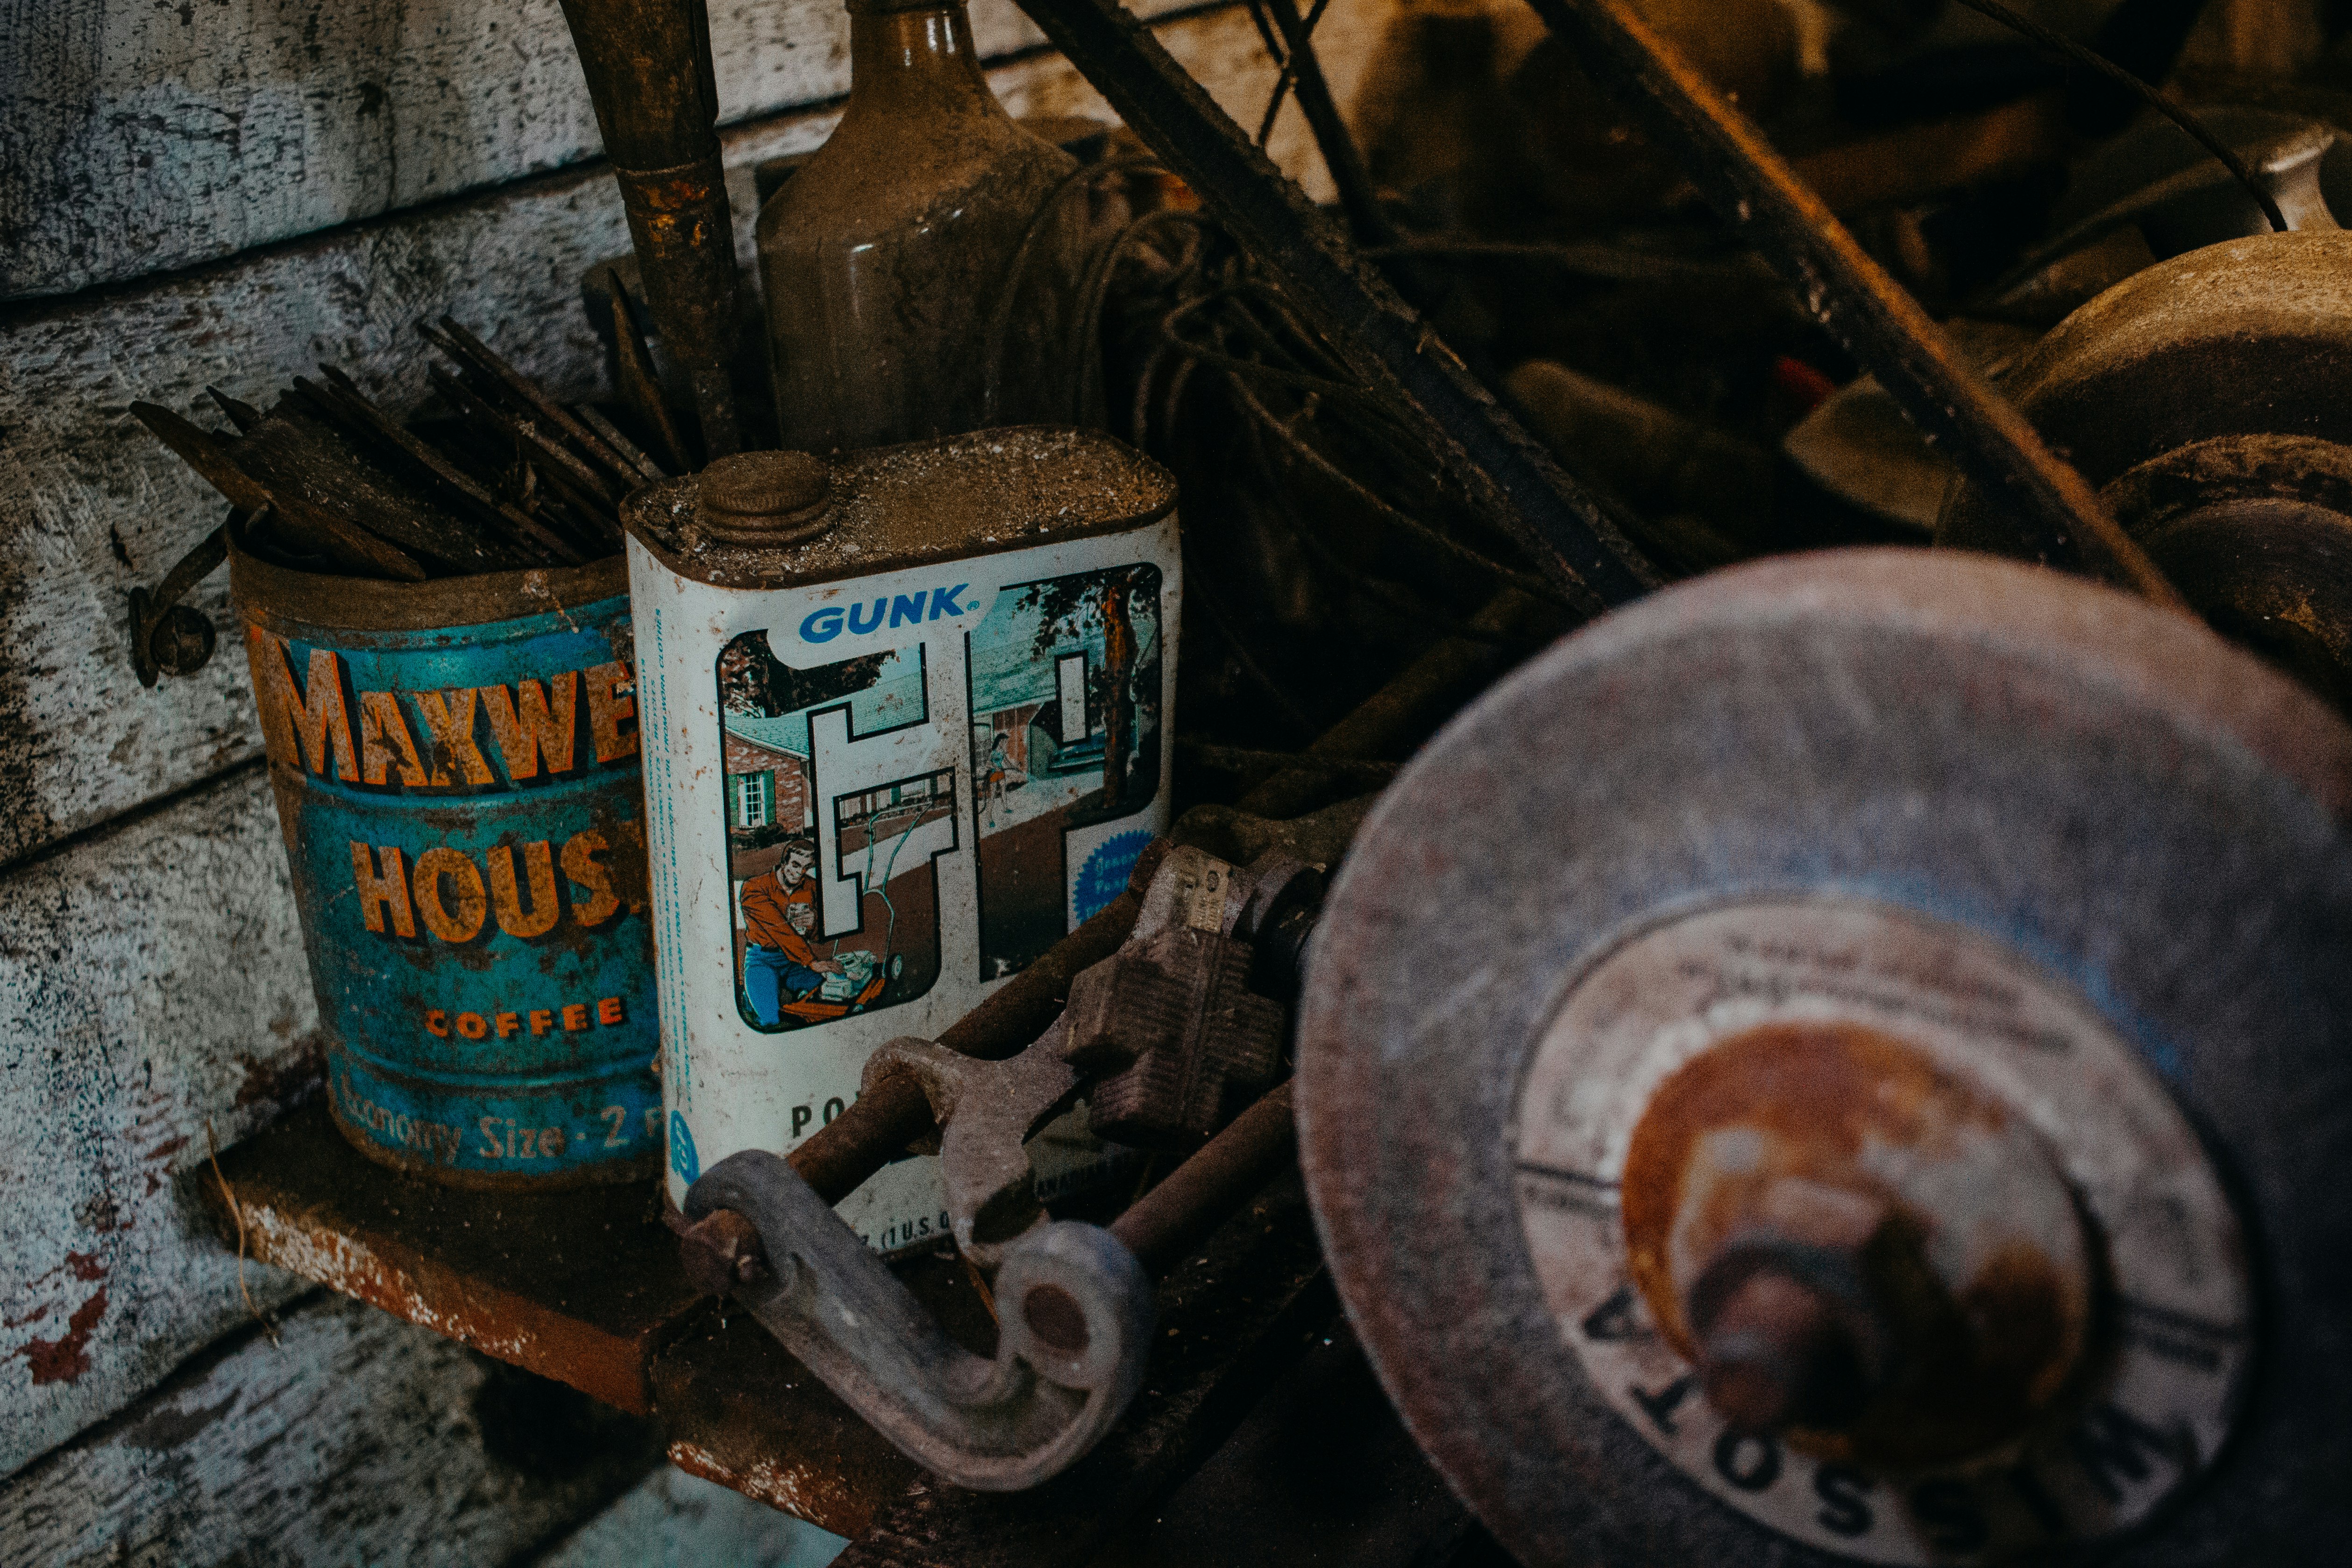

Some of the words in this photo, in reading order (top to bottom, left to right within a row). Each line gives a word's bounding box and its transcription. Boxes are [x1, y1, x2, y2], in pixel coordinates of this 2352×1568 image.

[799, 582, 970, 644] GUNK
[425, 996, 622, 1040] COFFEE
[479, 1115, 565, 1159] Size
[601, 1105, 630, 1148] 2
